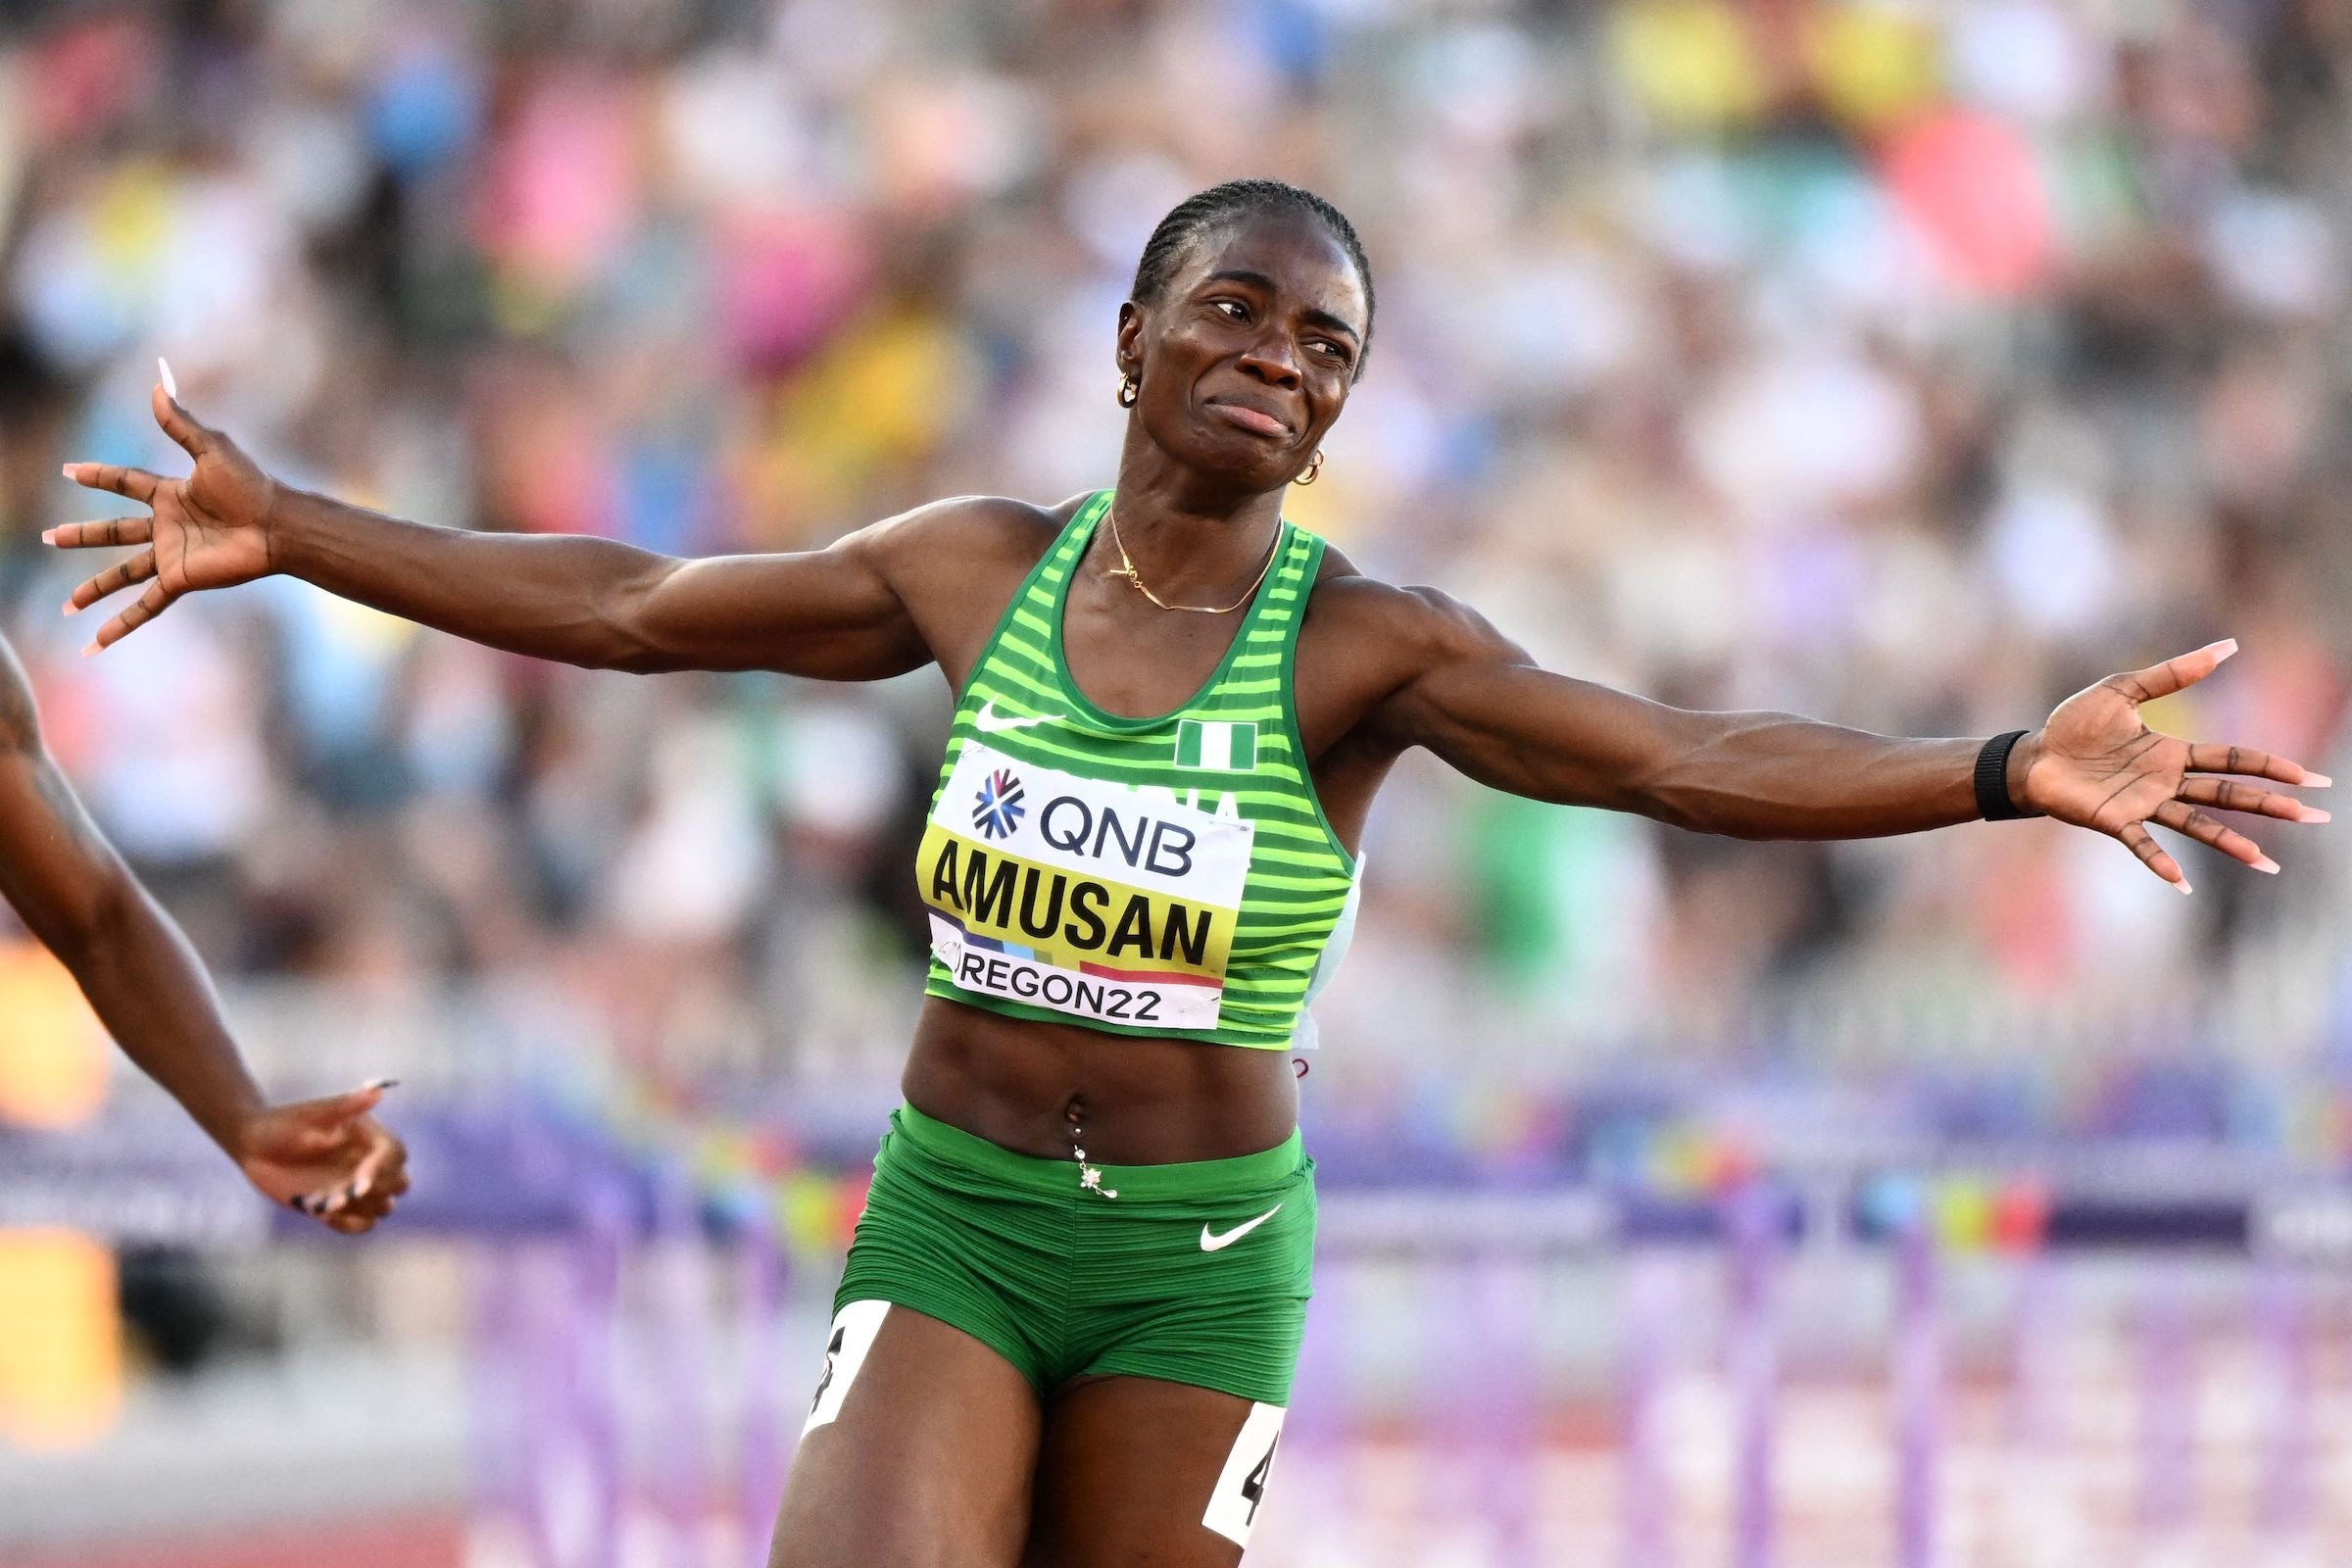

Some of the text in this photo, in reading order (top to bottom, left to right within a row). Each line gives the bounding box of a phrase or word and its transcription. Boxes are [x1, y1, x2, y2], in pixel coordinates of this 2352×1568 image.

[1040, 796, 1196, 877] QNB
[932, 839, 1213, 965] AMUSAN
[954, 945, 1162, 1021] REGON22
[1241, 1430, 1280, 1527] 4
